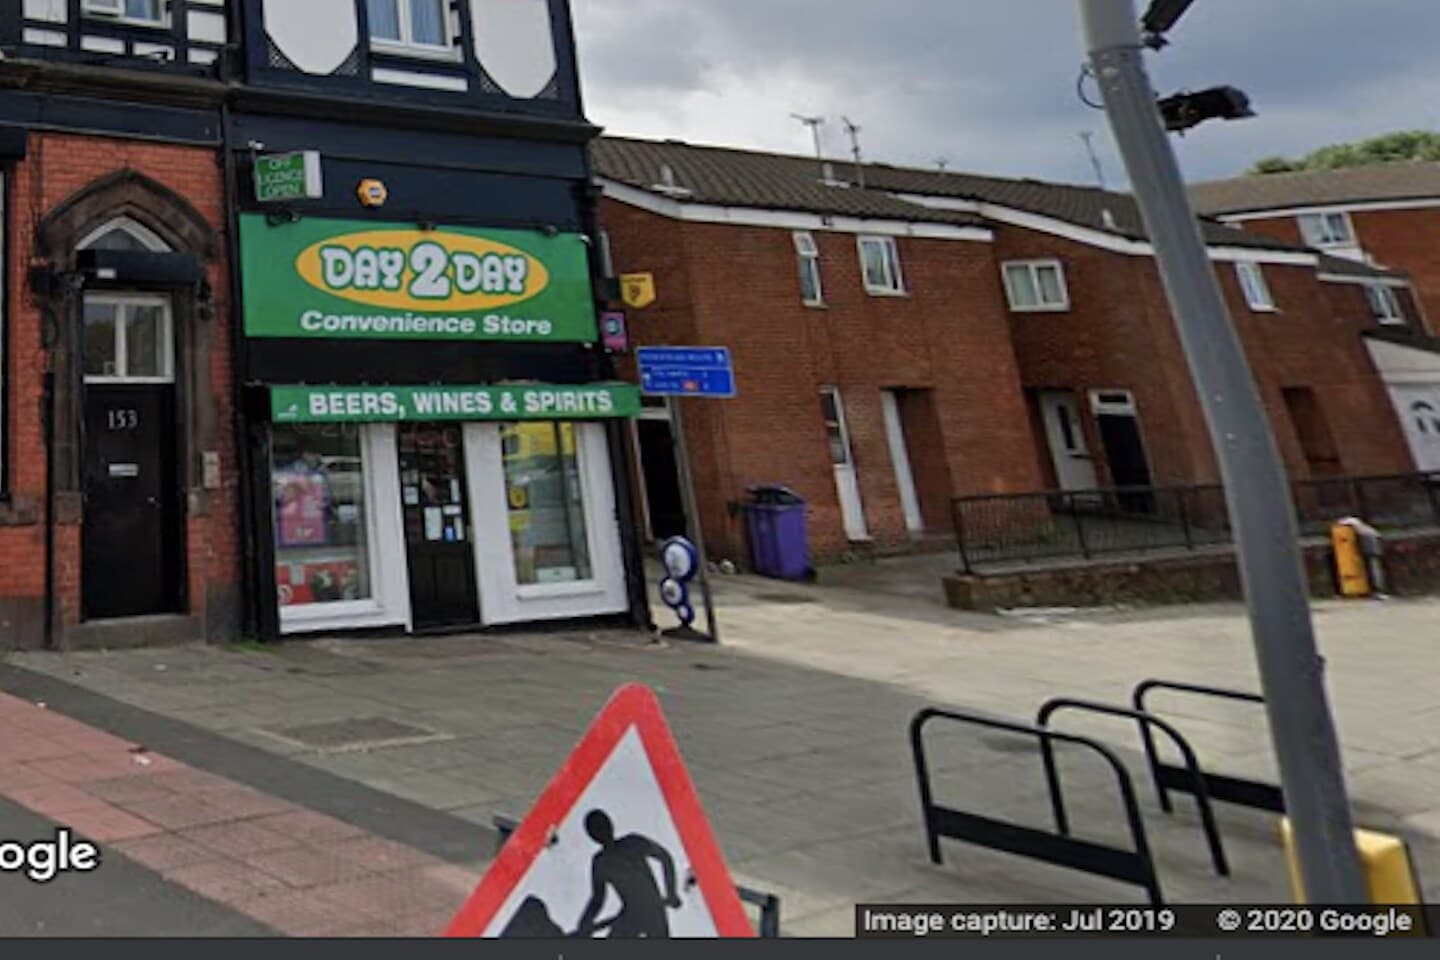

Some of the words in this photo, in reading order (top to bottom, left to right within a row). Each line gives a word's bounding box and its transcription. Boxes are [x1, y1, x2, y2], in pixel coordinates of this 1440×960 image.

[320, 246, 405, 289] DAY
[409, 241, 451, 298] 2
[452, 252, 527, 294] DAY
[300, 309, 477, 334] Convenience
[482, 314, 553, 335] Store
[309, 391, 407, 419] BEERS,
[412, 390, 492, 414] WINES
[499, 391, 517, 414] &
[524, 389, 613, 414] SPIRITS
[107, 408, 138, 430] 153
